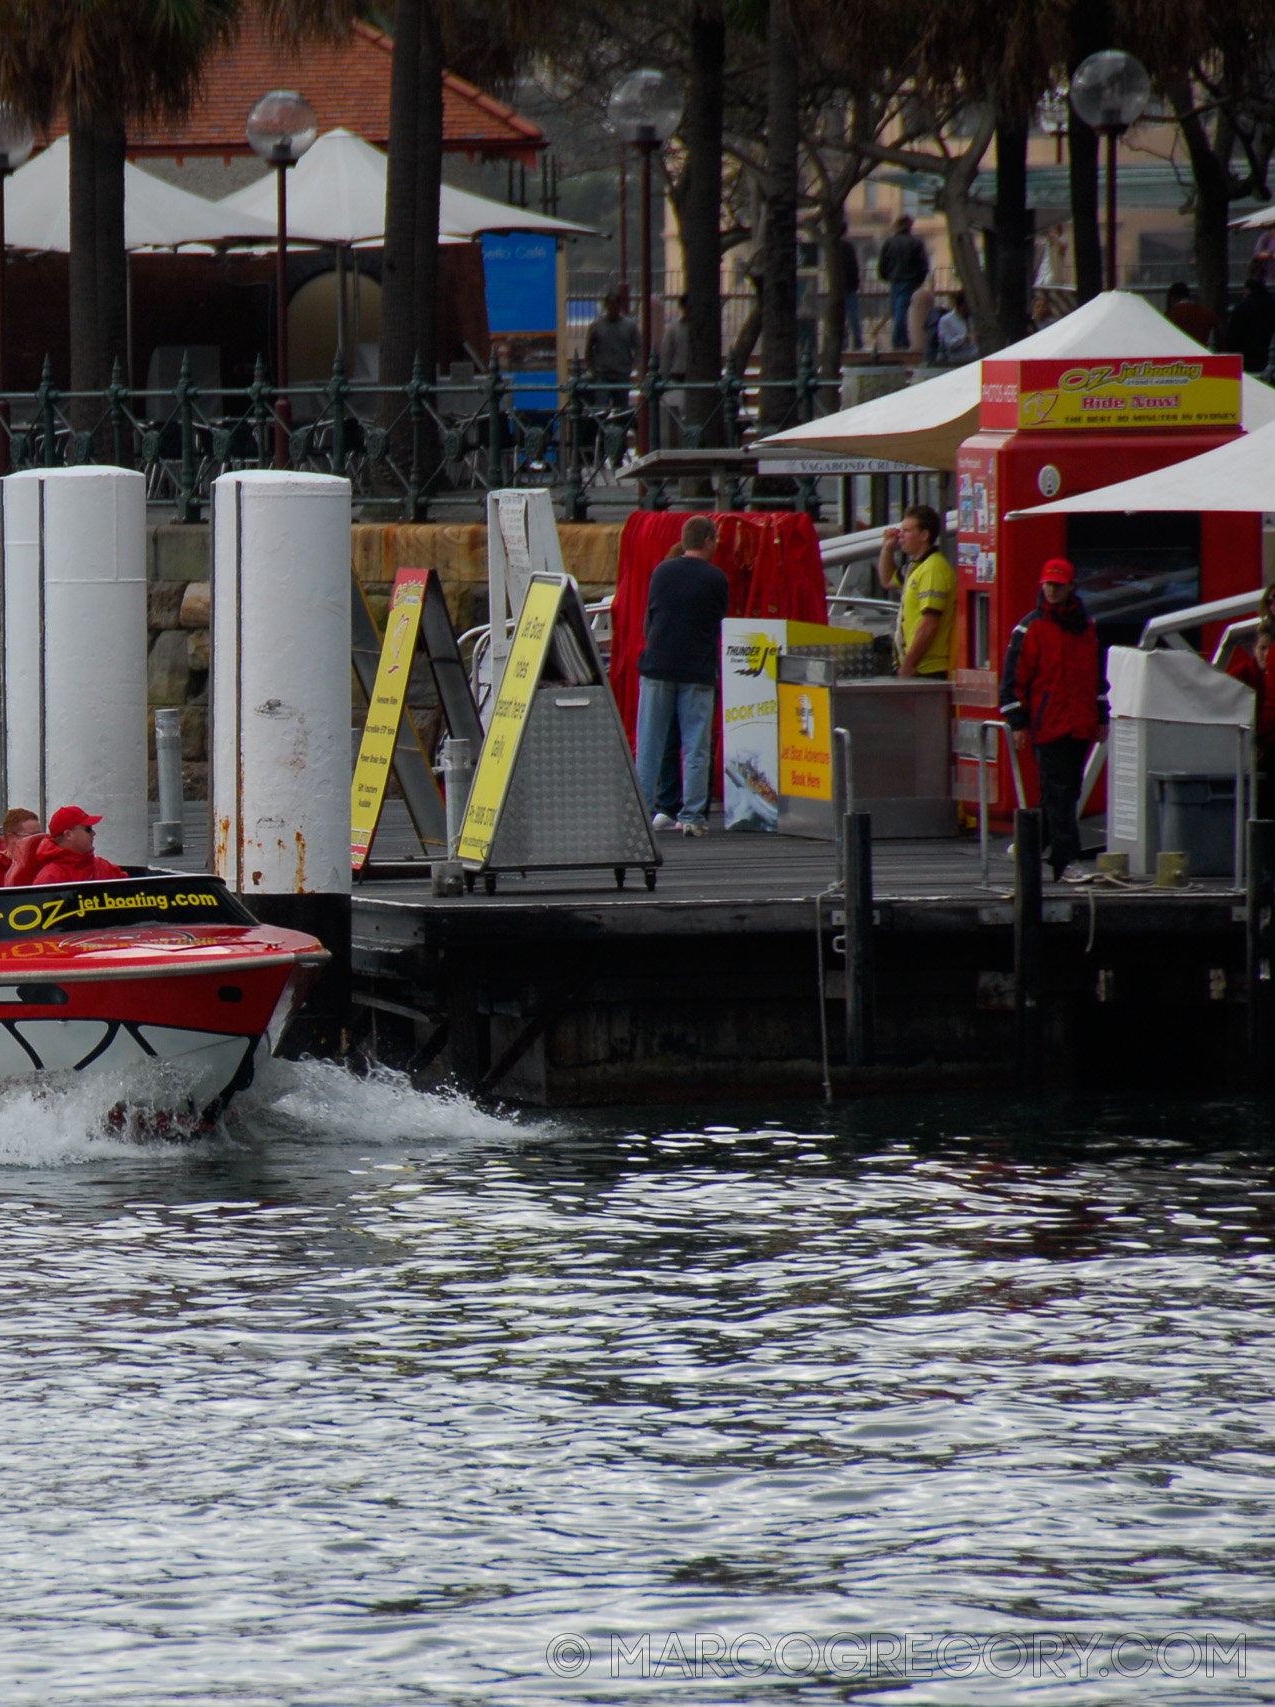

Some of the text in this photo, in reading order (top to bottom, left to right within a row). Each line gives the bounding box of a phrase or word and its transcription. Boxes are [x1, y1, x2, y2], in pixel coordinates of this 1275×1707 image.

[1058, 366, 1114, 392] OZ
[1141, 359, 1203, 381] boating
[1080, 393, 1180, 410] Ride Now!
[1086, 415, 1111, 423] BEST
[1133, 414, 1178, 422] MINUTES
[1182, 413, 1193, 421] IN
[800, 461, 865, 472] VAGABOND
[726, 646, 761, 656] THUNDER
[725, 704, 755, 723] BOOK
[757, 700, 777, 716] HER
[8, 899, 65, 930] OZ
[77, 894, 100, 916] jet
[103, 892, 168, 910] boating
[171, 892, 218, 907] .com
